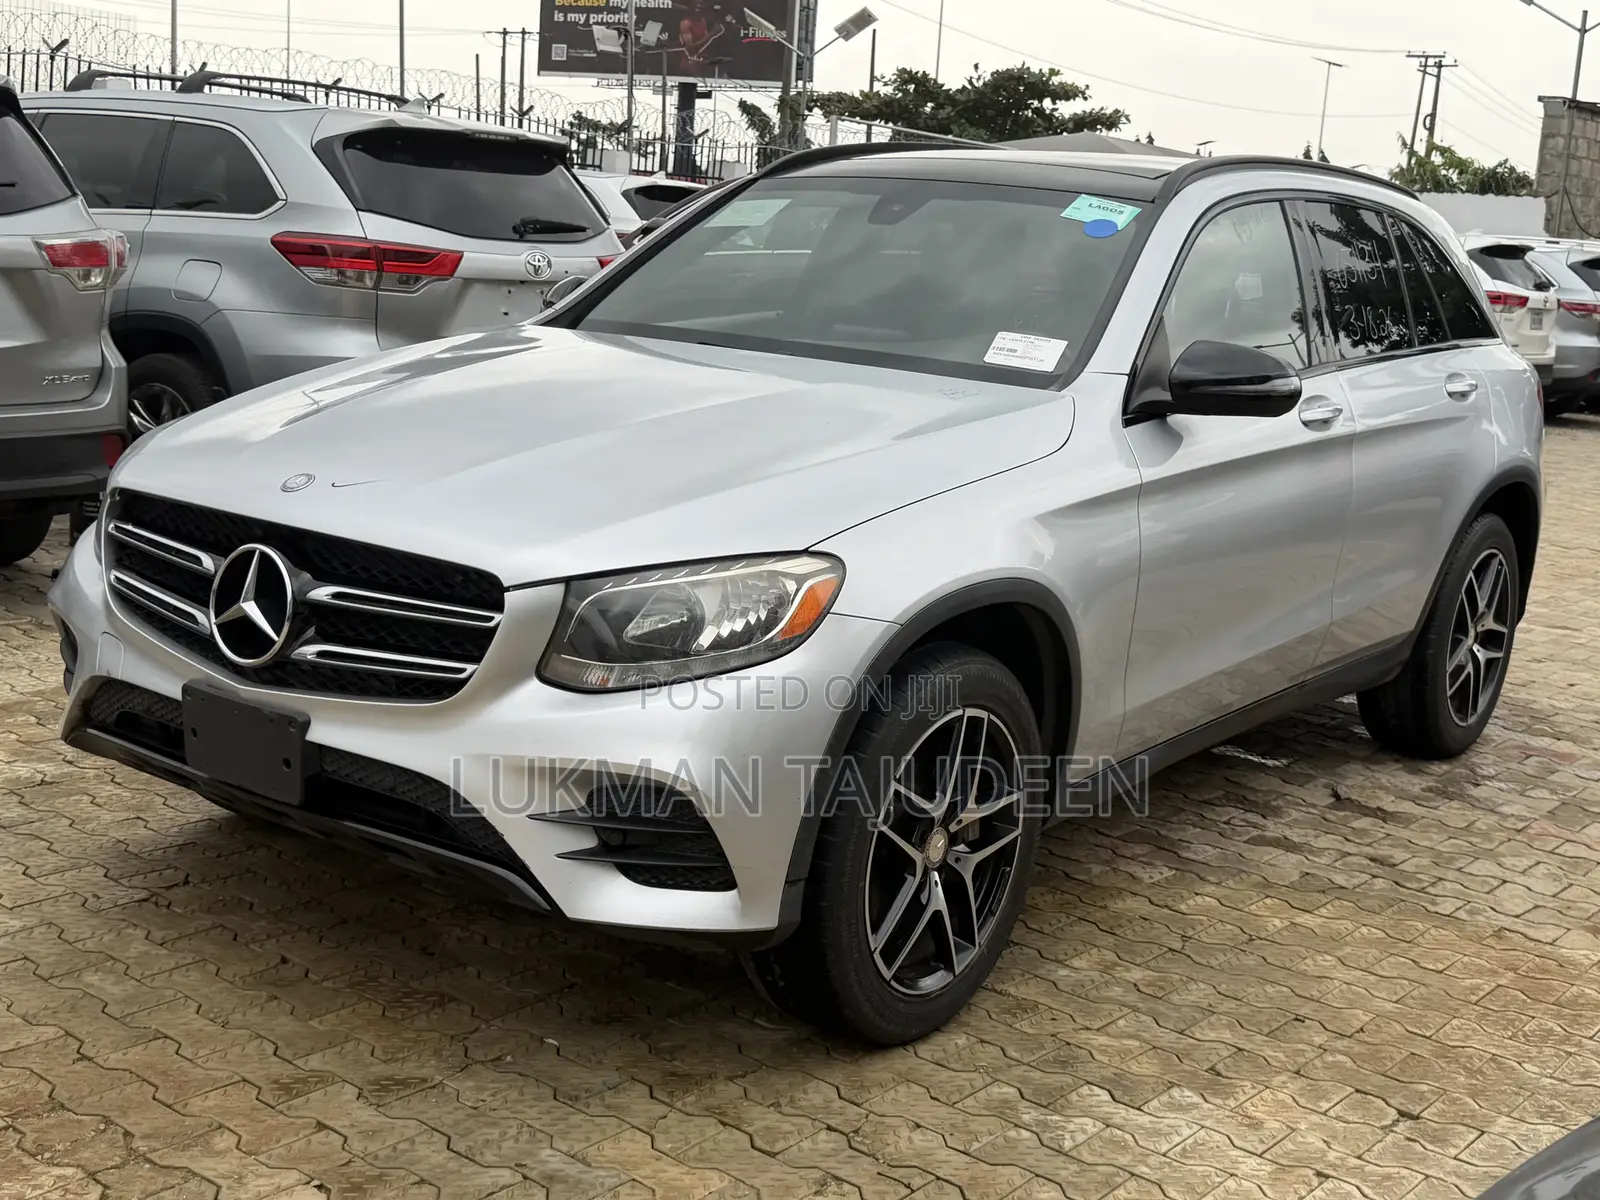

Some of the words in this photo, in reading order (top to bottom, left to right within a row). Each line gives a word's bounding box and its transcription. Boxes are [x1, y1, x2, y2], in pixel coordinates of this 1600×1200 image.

[609, 0, 629, 9] my
[554, 10, 565, 22] is
[567, 13, 587, 24] my
[1088, 203, 1125, 215] LAGOS
